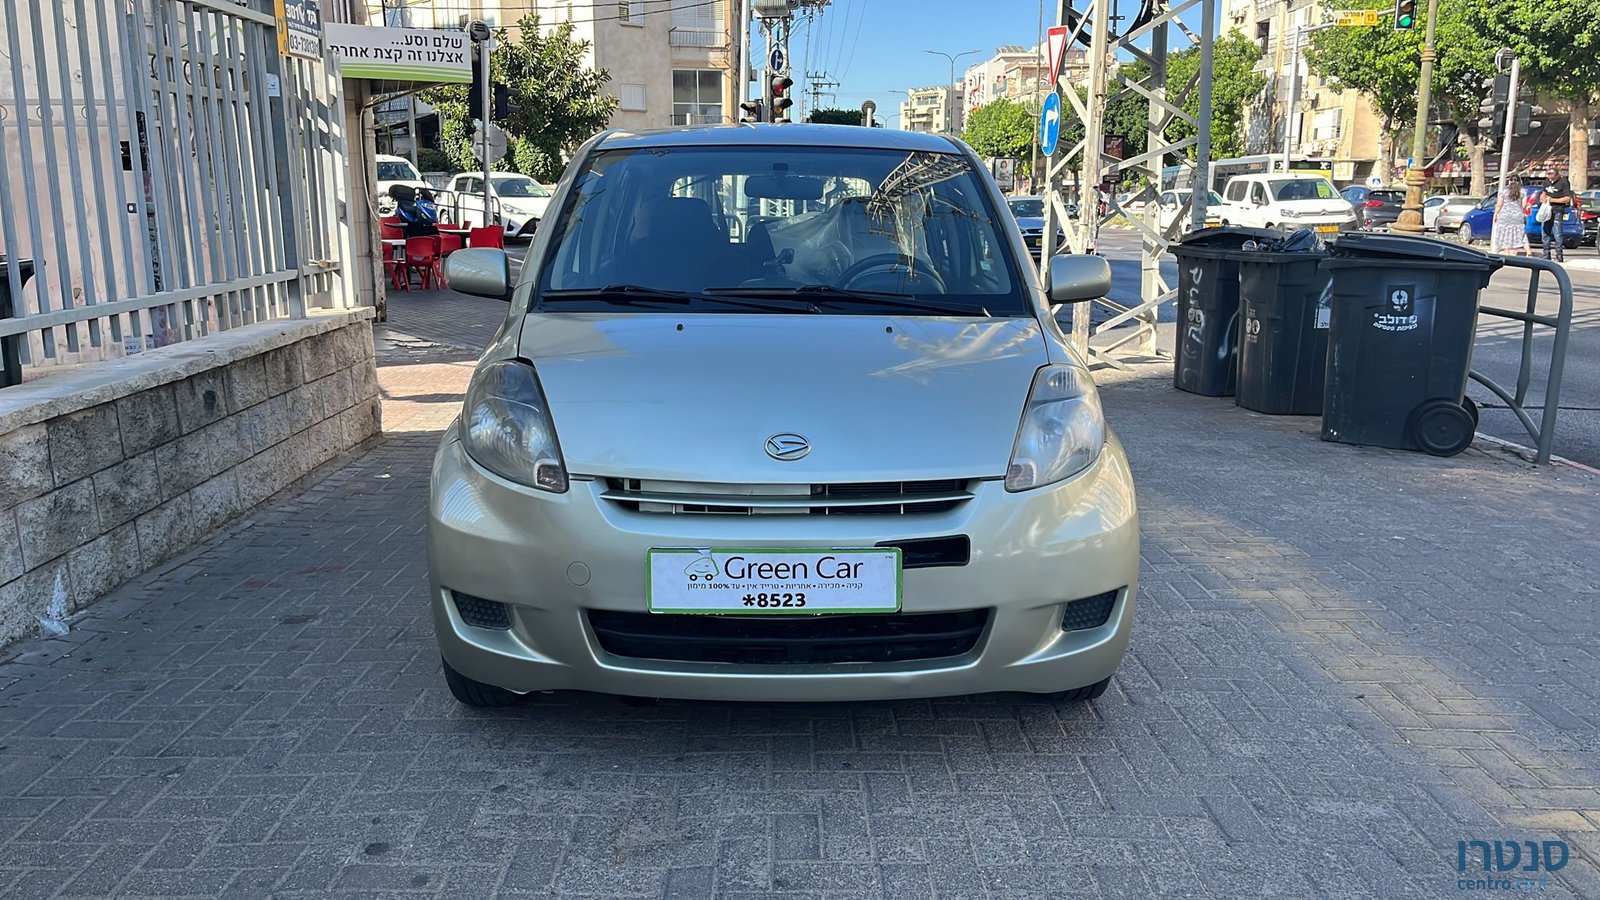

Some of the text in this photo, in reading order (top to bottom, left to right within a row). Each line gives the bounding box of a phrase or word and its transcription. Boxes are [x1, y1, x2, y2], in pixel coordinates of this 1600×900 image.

[391, 34, 463, 49] שלם וסע...
[374, 48, 402, 63] קצת
[408, 50, 422, 61] זה
[427, 49, 463, 63] אצלנו
[724, 556, 864, 579] Green Car
[846, 582, 863, 590] קניה
